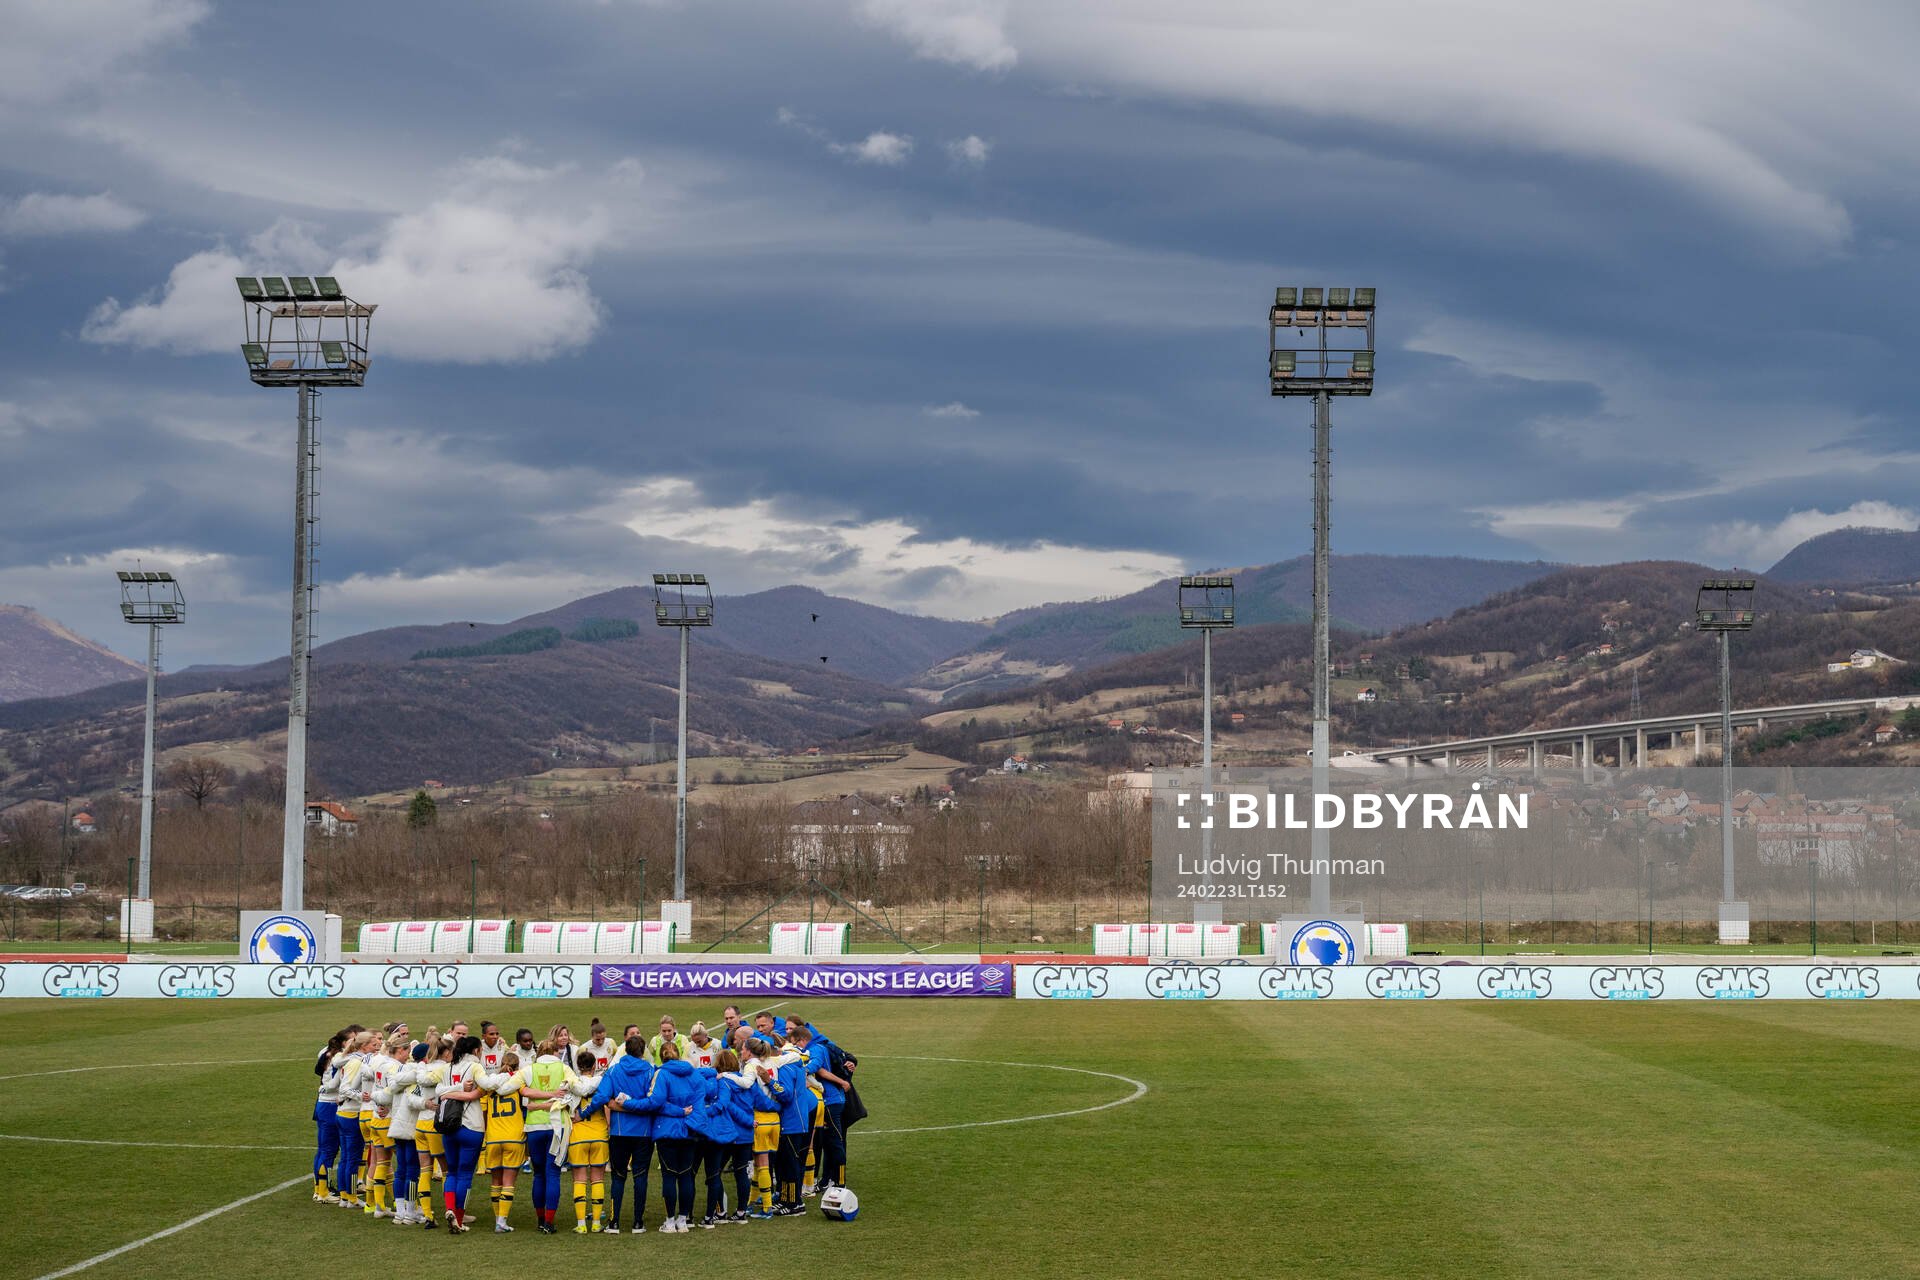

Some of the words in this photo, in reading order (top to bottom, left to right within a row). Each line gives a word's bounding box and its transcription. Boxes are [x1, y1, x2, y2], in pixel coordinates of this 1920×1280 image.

[43, 965, 120, 996] GMS
[158, 965, 235, 997] GMS
[268, 965, 345, 997] GMS
[382, 965, 458, 997] GMS
[497, 965, 574, 997] GMS
[630, 971, 684, 988] UEFA
[686, 971, 787, 988] WOMEN'S
[793, 971, 886, 989] NATIONS
[892, 971, 973, 989] LEAGUE
[1033, 966, 1108, 998] GMS
[1145, 967, 1220, 998] GMS
[1259, 967, 1333, 998] GMS
[1366, 967, 1440, 998] GMS
[1477, 967, 1552, 998] GMS
[1590, 967, 1664, 998] GMS
[1696, 967, 1770, 998] GMS
[1806, 967, 1880, 998] GMS
[66, 988, 98, 996] SPORT
[180, 988, 213, 996] SPORT
[290, 988, 323, 996] SPORT
[406, 989, 438, 997] SPORT
[521, 989, 552, 997] SPORT
[1056, 990, 1088, 998] SPORT
[1168, 990, 1200, 998] SPORT
[1281, 990, 1313, 998] SPORT
[1389, 990, 1420, 998] SPORT
[1501, 990, 1532, 998] SPORT
[1613, 990, 1645, 998] SPORT
[1720, 990, 1751, 998] SPORT
[1829, 990, 1861, 998] SPORT
[491, 1093, 516, 1118] 15
